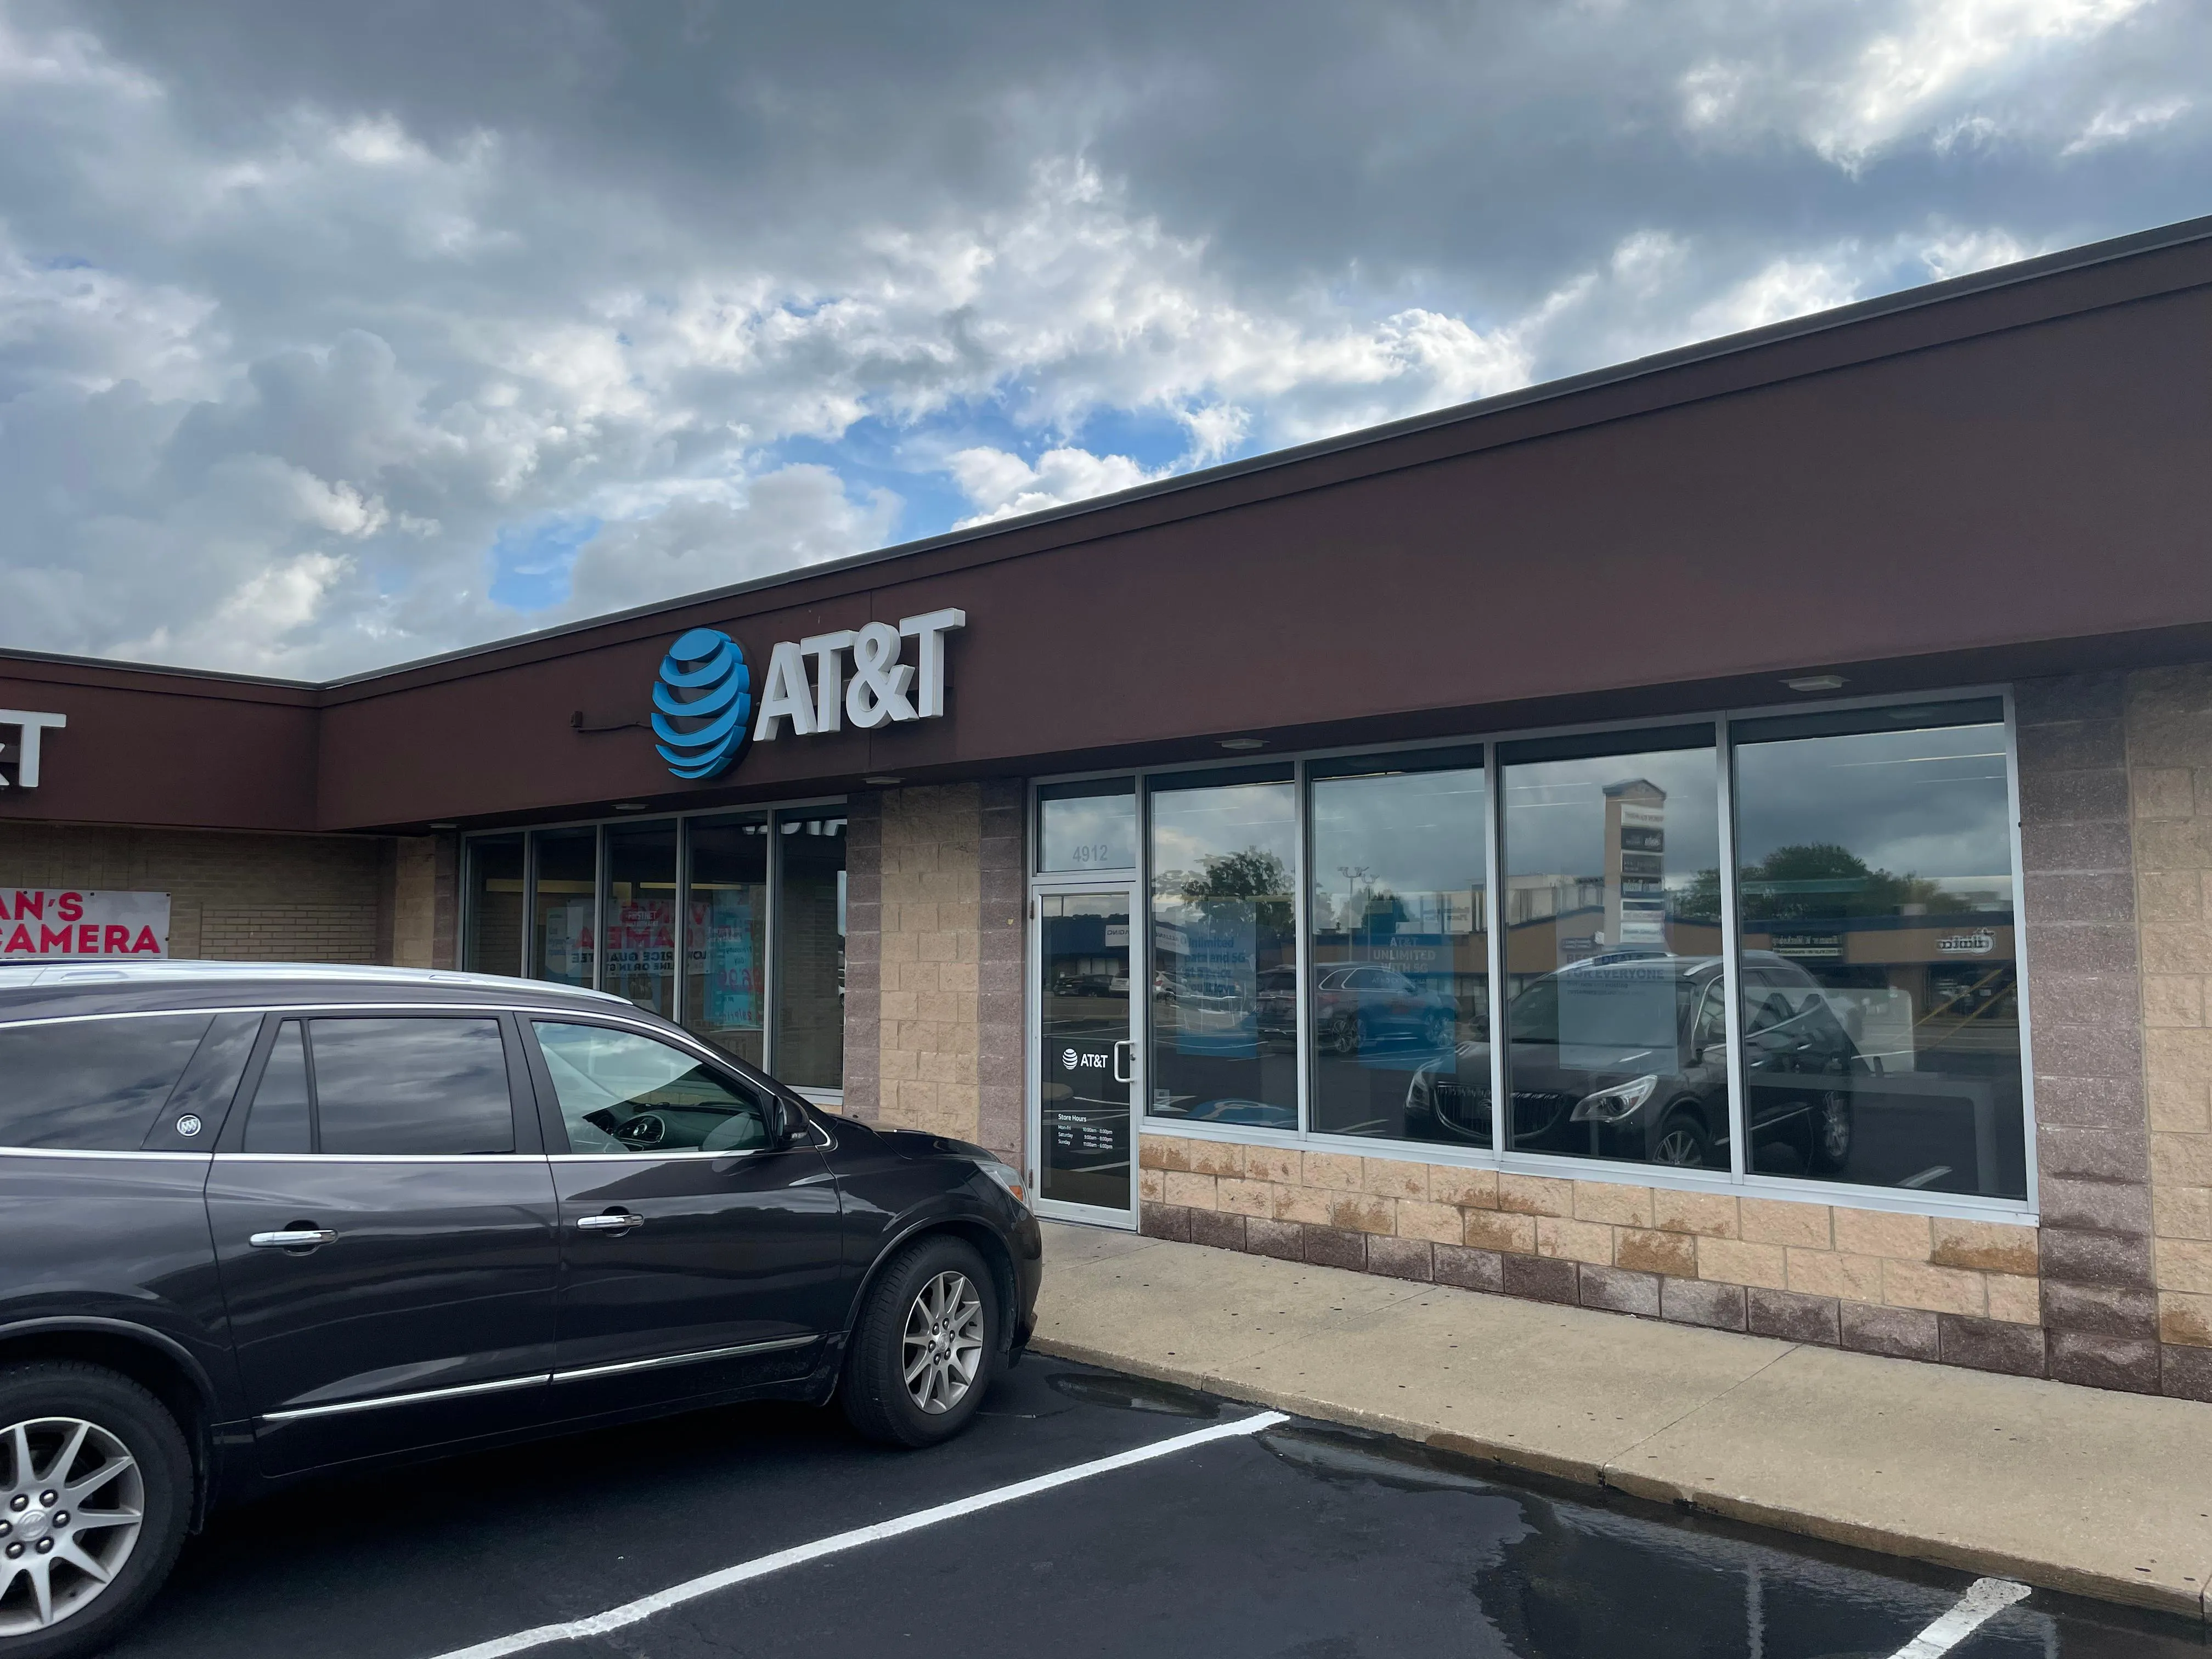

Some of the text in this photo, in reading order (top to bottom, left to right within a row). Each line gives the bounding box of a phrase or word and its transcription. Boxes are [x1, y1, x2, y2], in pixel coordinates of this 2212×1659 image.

[753, 607, 966, 742] AT&T
[0, 709, 66, 788] T
[1072, 845, 1108, 862] 4912
[0, 923, 161, 953] AMERA
[1373, 949, 1436, 961] UNLIMITED
[1595, 969, 1664, 980] EVERYONE
[1080, 1053, 1108, 1068] AT&T
[1072, 1114, 1087, 1122] Hours
